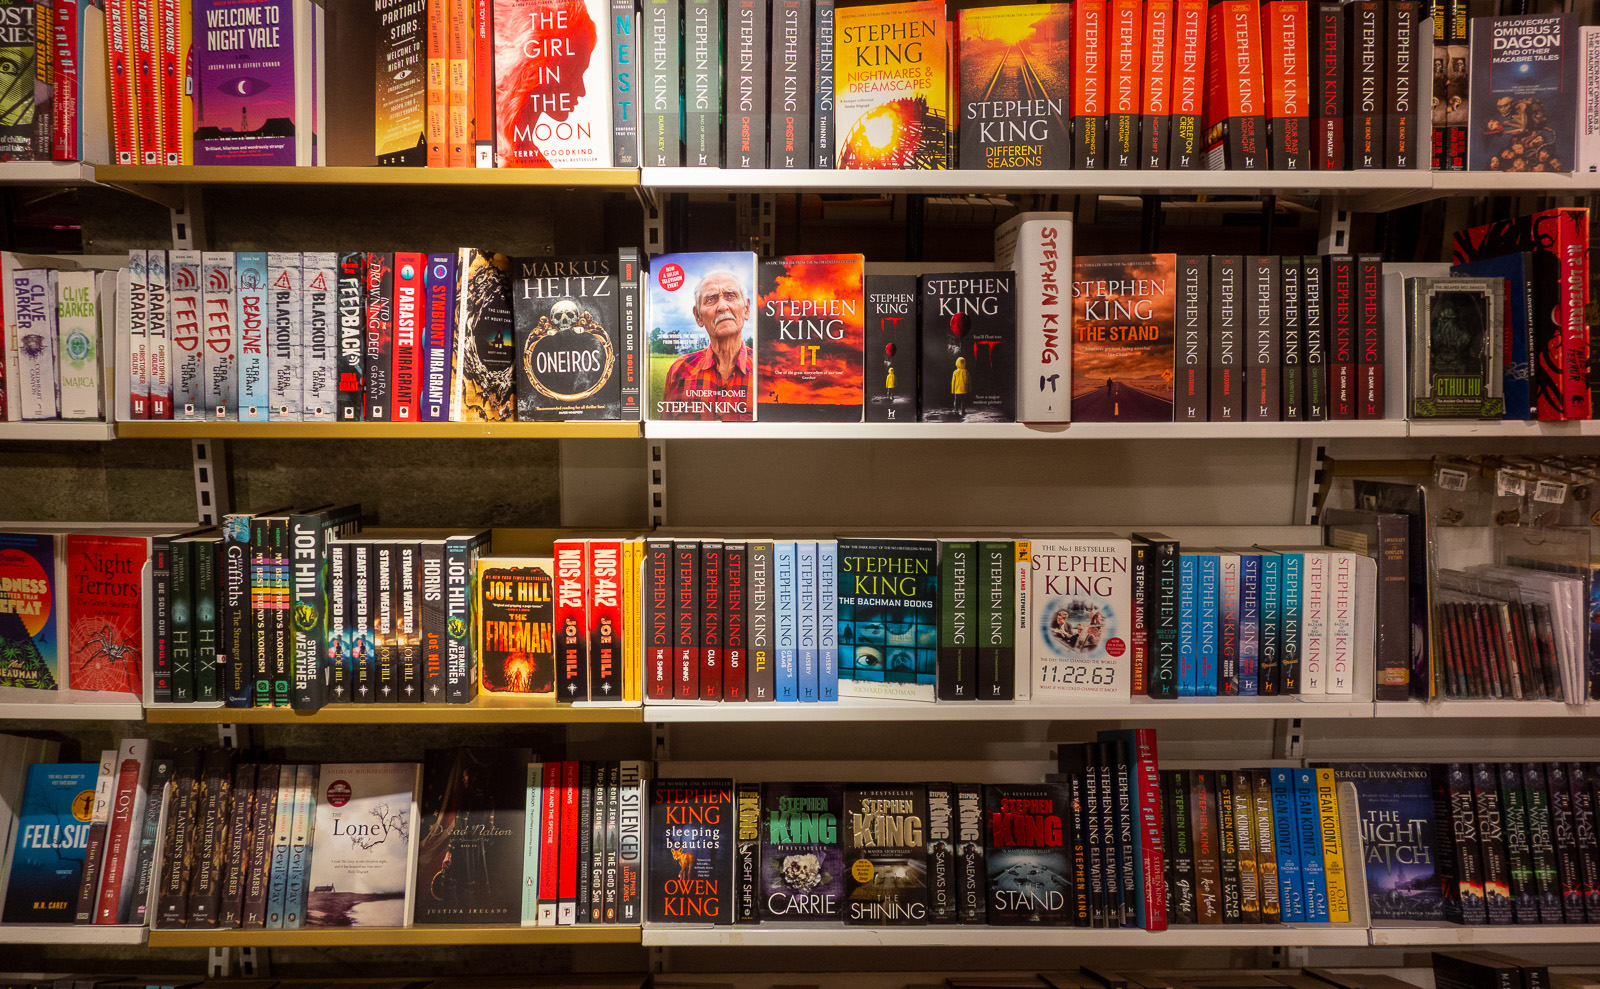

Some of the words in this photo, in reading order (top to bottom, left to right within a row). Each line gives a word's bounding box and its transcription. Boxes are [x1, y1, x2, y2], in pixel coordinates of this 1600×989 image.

[207, 8, 262, 28] WELCOME
[265, 6, 279, 24] TO
[382, 1, 426, 26] PARTIALLY
[529, 11, 568, 30] THE
[1509, 18, 1560, 27] LOVECRAFT
[137, 8, 149, 53] DEVOURS!
[207, 29, 246, 51] NIGHT
[248, 27, 279, 49] VALE
[390, 20, 421, 40] STARS.
[654, 8, 666, 70] STEPHEN
[821, 10, 833, 72] STEPHEN
[843, 20, 936, 43] STEPHEN
[1493, 34, 1561, 49] DAGON
[1494, 26, 1549, 37] OMNIBUS
[1552, 26, 1560, 34] 2
[523, 38, 575, 58] GIRL
[856, 42, 923, 67] KING
[538, 66, 560, 84] IN
[616, 15, 631, 121] NEST
[847, 67, 922, 83] NIGHTMARES
[925, 66, 934, 77] &
[654, 74, 667, 110] KING
[821, 75, 832, 111] KING
[849, 78, 932, 94] DREAMSCAPES
[531, 93, 571, 112] THE
[967, 98, 1063, 120] STEPHEN
[513, 122, 592, 142] MOON
[979, 119, 1049, 143] KING
[514, 150, 538, 158] TERRY
[543, 149, 593, 157] GOODKIND
[985, 144, 1043, 158] DIFFERENT
[986, 156, 1042, 168] SEASONS
[522, 260, 610, 277] MARKUS
[1041, 226, 1058, 306] STEPHEN
[63, 286, 89, 302] CLIVE
[522, 276, 611, 300] HEITZ
[927, 278, 1009, 296] STEPHEN
[1072, 280, 1166, 299] STEPHEN
[59, 302, 95, 318] BARKER
[130, 282, 146, 338] ARARAT
[626, 295, 632, 307] WE
[765, 299, 856, 317] STEPHEN
[939, 296, 999, 317] KING
[1084, 300, 1153, 321] KING
[1568, 269, 1584, 341] LOVECRAFT
[174, 296, 199, 352] FEED
[242, 296, 262, 354] DEADLINE
[276, 291, 291, 360] BLACKOUT
[339, 278, 361, 358] FEEDBACK
[398, 287, 415, 346] PARASITE
[430, 285, 447, 347] SYMBIONT
[779, 319, 845, 341] KING
[1041, 313, 1060, 365] KING
[1077, 326, 1107, 342] THE
[1109, 326, 1160, 342] STAND
[138, 344, 146, 385] CHRISTOPHER
[187, 354, 196, 380] MIRA
[536, 350, 600, 374] ONEIROS
[799, 345, 821, 366] IT
[181, 365, 189, 394] GRANT
[1040, 373, 1060, 394] IT
[1437, 378, 1481, 396] CTHULHU
[686, 390, 713, 398] UNDER
[721, 390, 746, 398] DOME
[656, 401, 712, 413] STEPHEN
[714, 401, 747, 414] KING
[294, 524, 316, 560] JOE
[82, 552, 133, 580] Night
[843, 556, 929, 574] STEPHEN
[1031, 554, 1128, 574] STEPHEN
[228, 546, 243, 608] Griffiths
[295, 563, 316, 602] HILL
[333, 548, 343, 618] HEART-SHAPED
[424, 558, 441, 601] HORNS
[594, 549, 618, 608] NOS4A2
[855, 576, 917, 597] KING
[1044, 575, 1113, 597] KING
[1311, 558, 1323, 619] STEPHEN
[486, 582, 513, 602] JOE
[518, 581, 551, 602] HILL
[838, 597, 855, 605] THE
[857, 598, 901, 608] BACHMAN
[904, 600, 933, 609] BOOKS
[333, 620, 344, 636] BOX
[508, 613, 527, 621] THE
[428, 632, 439, 652] JOE
[486, 620, 552, 654] FIREMAN
[295, 631, 307, 690] WEATHER
[307, 640, 316, 680] STRANGE
[428, 654, 440, 678] HILL
[756, 651, 766, 672] CELL
[1309, 638, 1320, 673] KING
[1042, 665, 1115, 685] 11.22.63
[1134, 647, 1143, 692] FIRESTARTER
[854, 686, 880, 694] RICHARD
[882, 688, 916, 696] BACHMAN
[1140, 745, 1159, 788] FLIGHT
[1334, 770, 1367, 778] SERGEI
[1369, 771, 1428, 779] LUKYANENKO
[621, 765, 639, 792] THE
[116, 789, 132, 822] LOST
[656, 788, 731, 805] STEPHEN
[1072, 779, 1080, 830] ELEVATION
[1319, 787, 1332, 814] DEAN
[666, 806, 721, 825] KING
[333, 818, 391, 838] Loney
[621, 794, 639, 861] SILENCED
[665, 827, 720, 839] sleeping
[770, 810, 837, 845] KING
[852, 813, 923, 848] KING
[992, 812, 1063, 848] KING
[1143, 807, 1162, 851] FRIGHT
[1322, 816, 1337, 856] KOONTZ
[231, 816, 244, 864] LANTERN'S
[666, 838, 720, 849] beauties
[743, 851, 752, 882] NIGHT
[1075, 845, 1086, 890] STEPHEN
[228, 866, 238, 896] EMBER
[664, 880, 718, 896] OWEN
[664, 897, 720, 917] KING
[744, 884, 752, 908] SHIFT
[768, 892, 836, 915] CARRIE
[876, 894, 899, 902] THE
[995, 890, 1064, 911] STAND
[1078, 894, 1086, 918] KING
[1306, 880, 1315, 919] Thomas
[1316, 893, 1326, 916] Odd
[851, 902, 926, 920] SHINING
